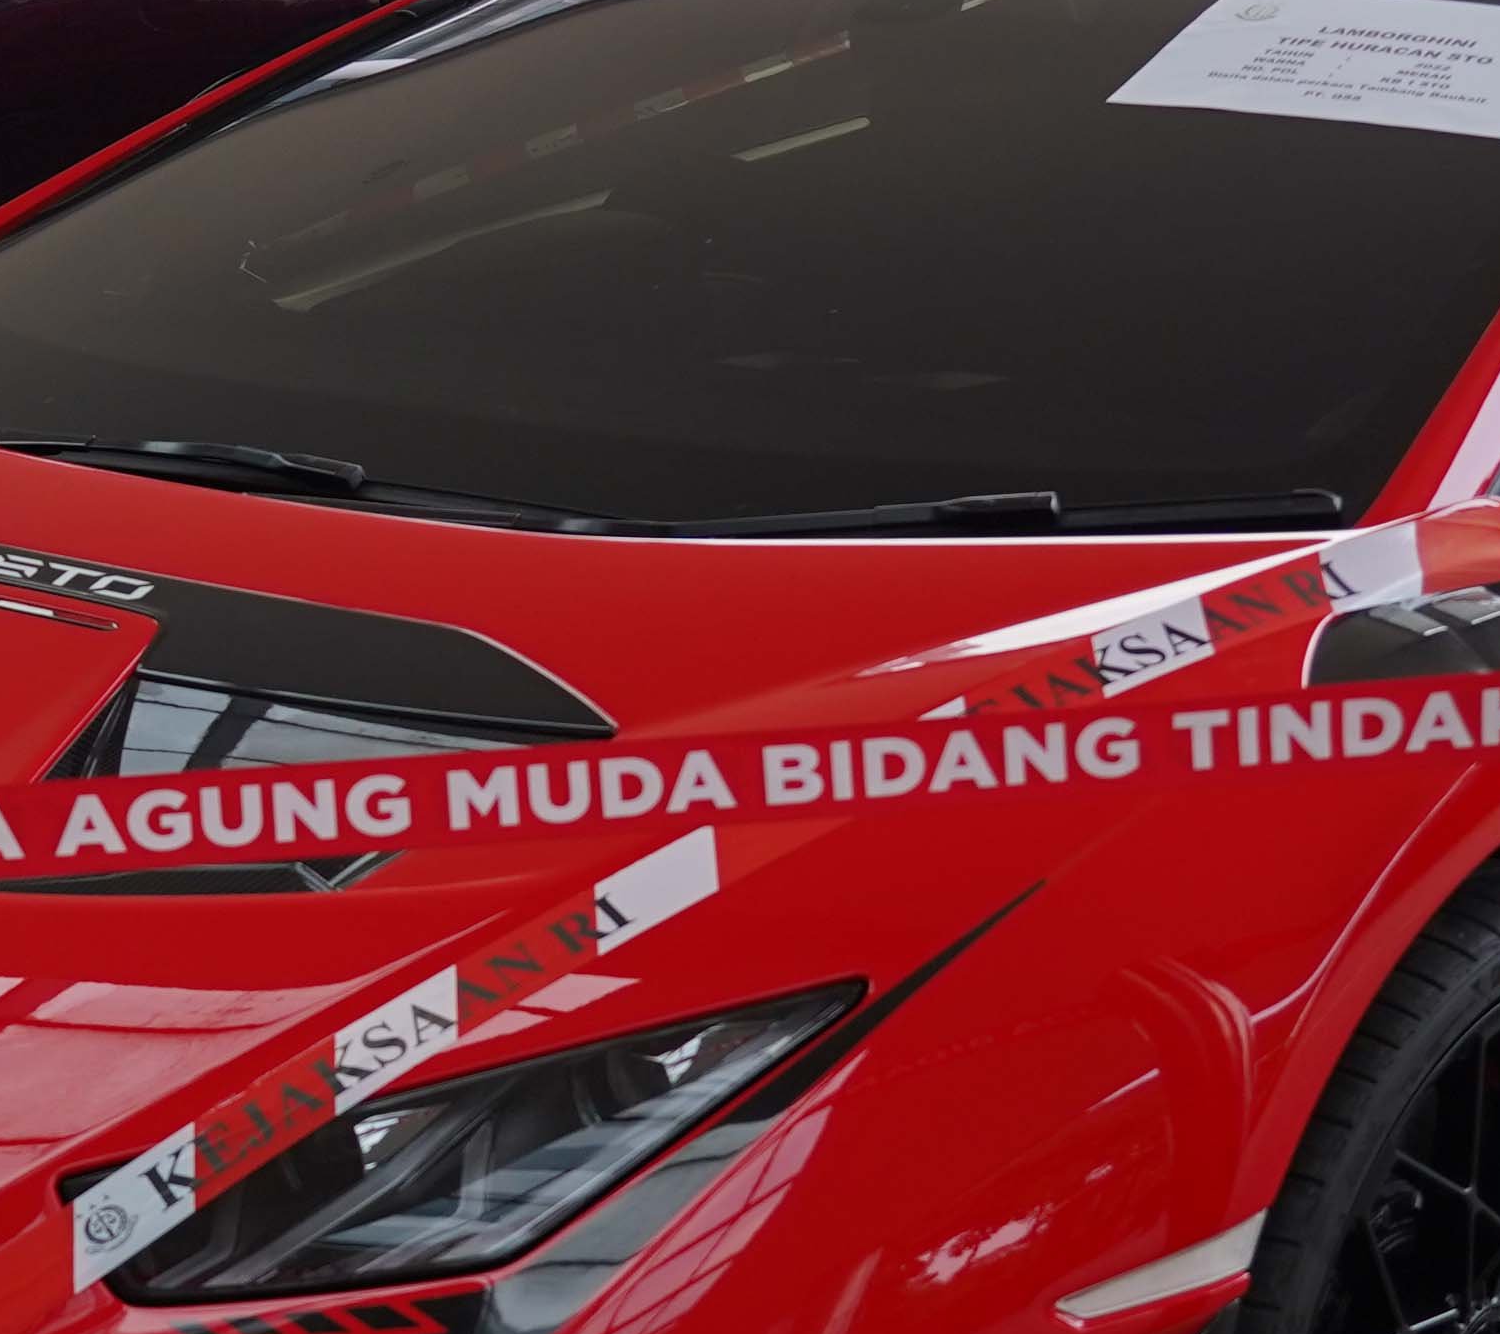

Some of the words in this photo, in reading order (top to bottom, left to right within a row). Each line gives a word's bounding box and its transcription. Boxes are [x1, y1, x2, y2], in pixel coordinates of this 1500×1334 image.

[1276, 35, 1329, 49] TIPE
[1330, 40, 1444, 59] HURACAN
[1445, 52, 1496, 66] STO
[1317, 25, 1478, 49] LAMBORGHINI
[1281, 560, 1361, 607] RI
[55, 772, 411, 858] AGUNG
[446, 749, 737, 831] MUDA
[762, 715, 1141, 808] BIDANG
[143, 938, 542, 1215] KEJAKSAAN
[553, 890, 636, 958] RI
